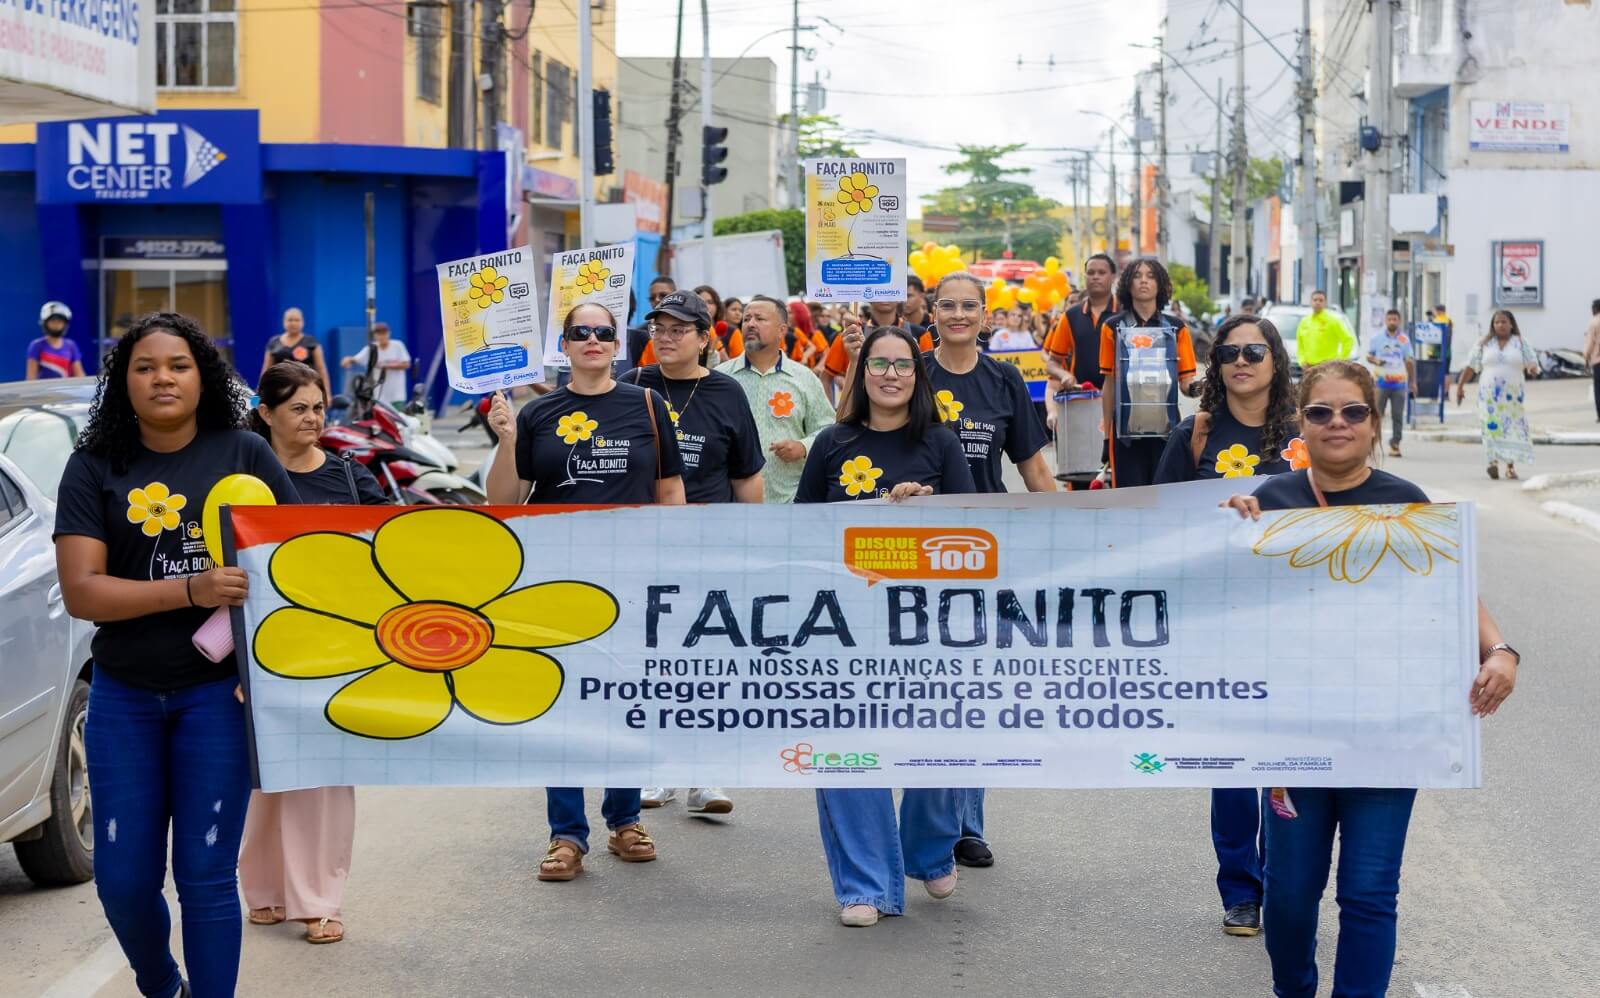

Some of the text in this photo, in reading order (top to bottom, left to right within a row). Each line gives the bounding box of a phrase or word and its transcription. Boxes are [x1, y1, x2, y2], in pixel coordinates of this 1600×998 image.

[1475, 119, 1566, 130] VENDE
[67, 123, 178, 165] NET
[67, 165, 172, 190] CENTER
[816, 162, 895, 177] FAÇA BONITO
[95, 190, 149, 199] TELECOM
[448, 251, 522, 278] FAÇA BONITO
[561, 247, 625, 266] FAÇA BONITO
[606, 439, 614, 447] DE
[576, 460, 598, 472] FAÇA
[599, 458, 627, 470] BONITO
[180, 521, 203, 540] 18
[854, 537, 917, 551] DISQUE
[163, 559, 190, 574] FAÇA
[854, 550, 986, 571] DIREITOS 100
[854, 560, 918, 570] HUMANOS
[645, 585, 1170, 656] FAÇA BONITO
[645, 658, 1169, 680] PROTEJA NOSSAS CRIANÇAS E ADOLESCENTES.
[580, 677, 1269, 703] Proteger nossas crianças e adolescentes
[625, 703, 1175, 732] é responsabilidade de todos.
